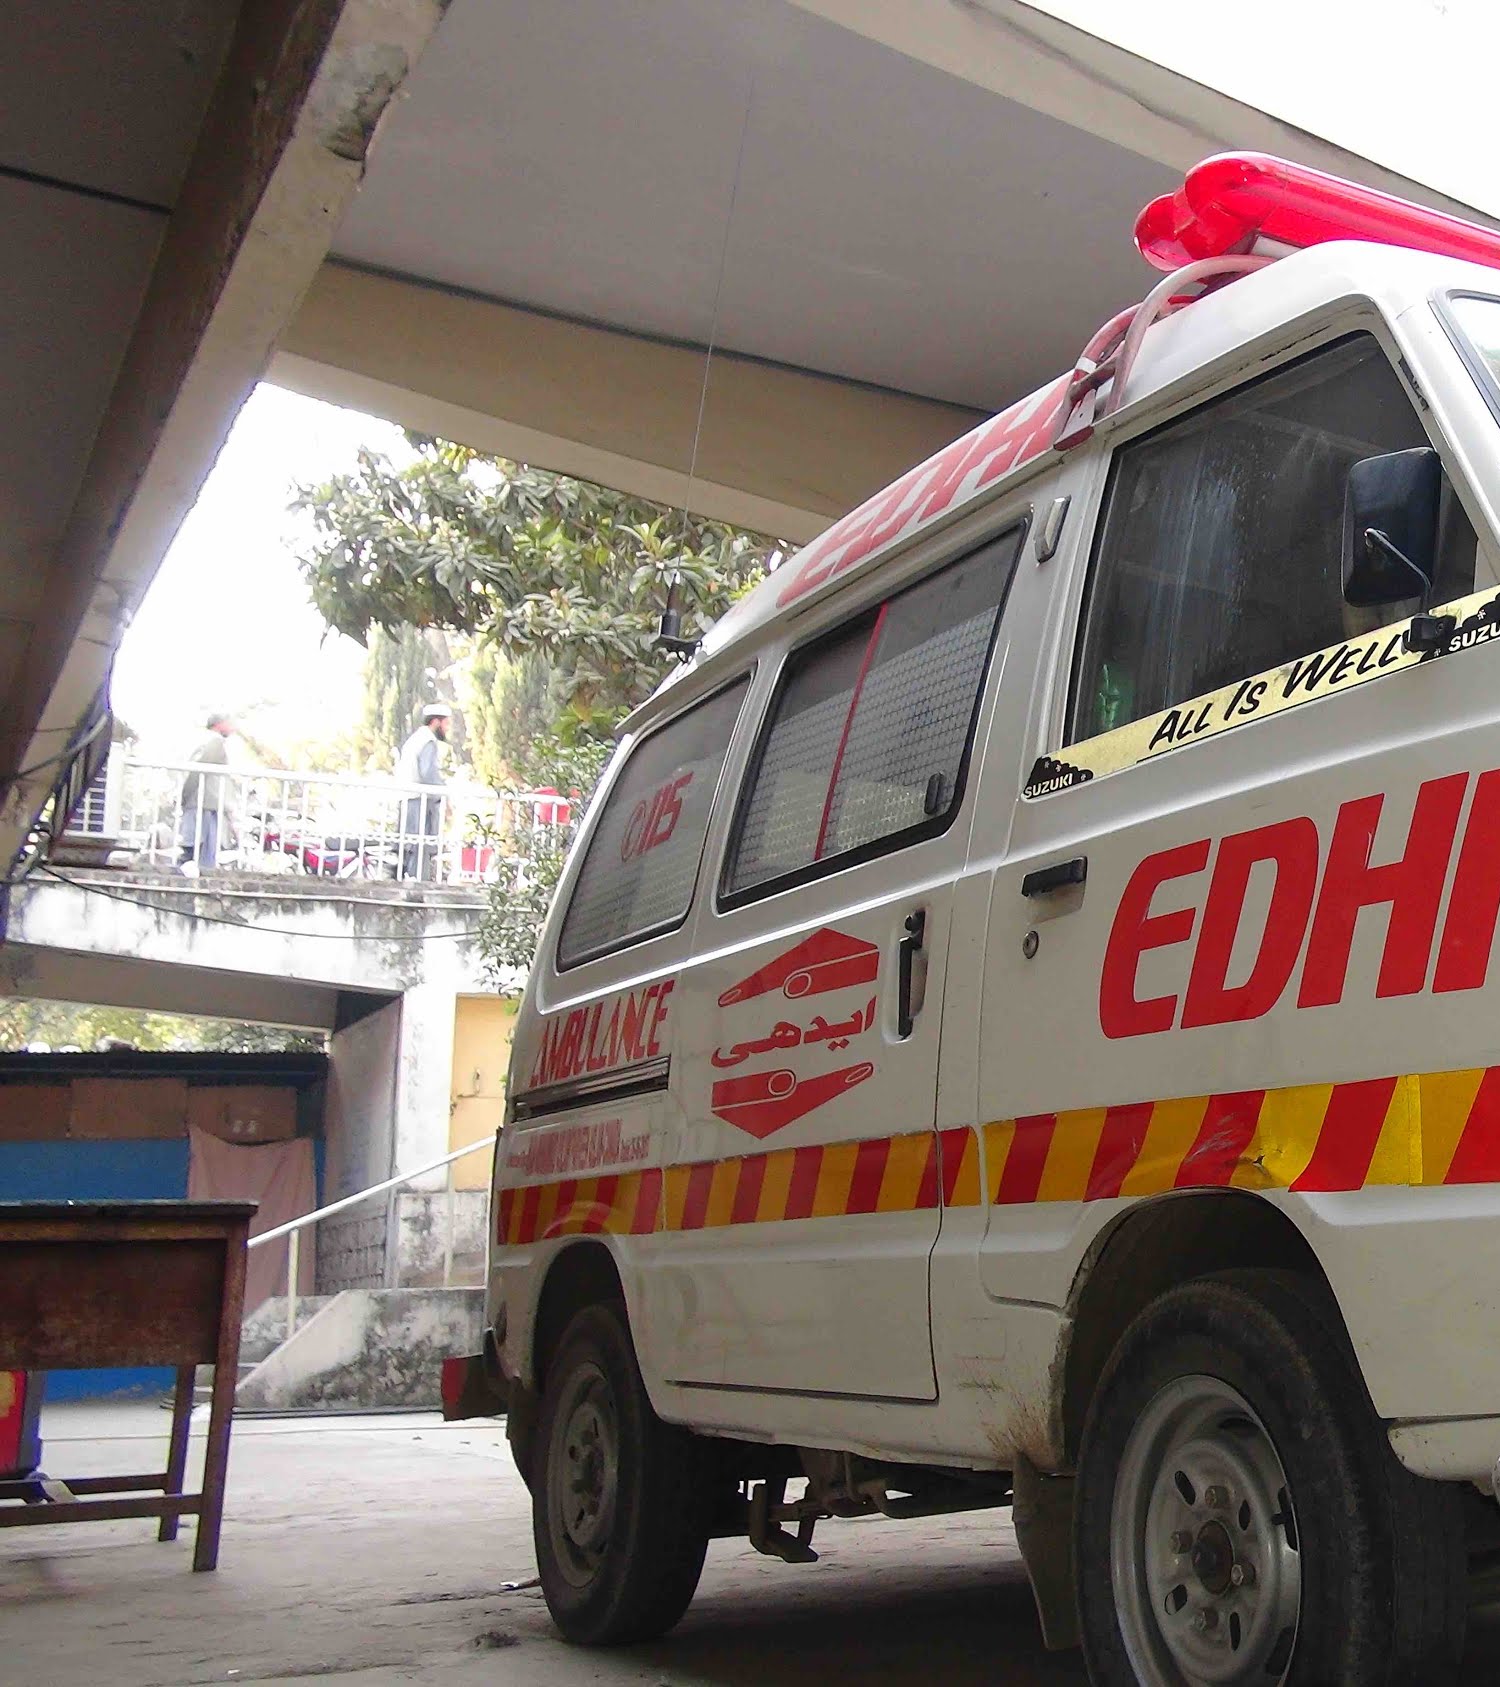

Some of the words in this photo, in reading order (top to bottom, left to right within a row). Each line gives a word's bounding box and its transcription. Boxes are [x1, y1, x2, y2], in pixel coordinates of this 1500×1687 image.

[1148, 702, 1213, 751] ALL
[1223, 681, 1268, 722] IS
[1023, 772, 1074, 799] SUZUKI
[528, 979, 676, 1089] AMBULANCE
